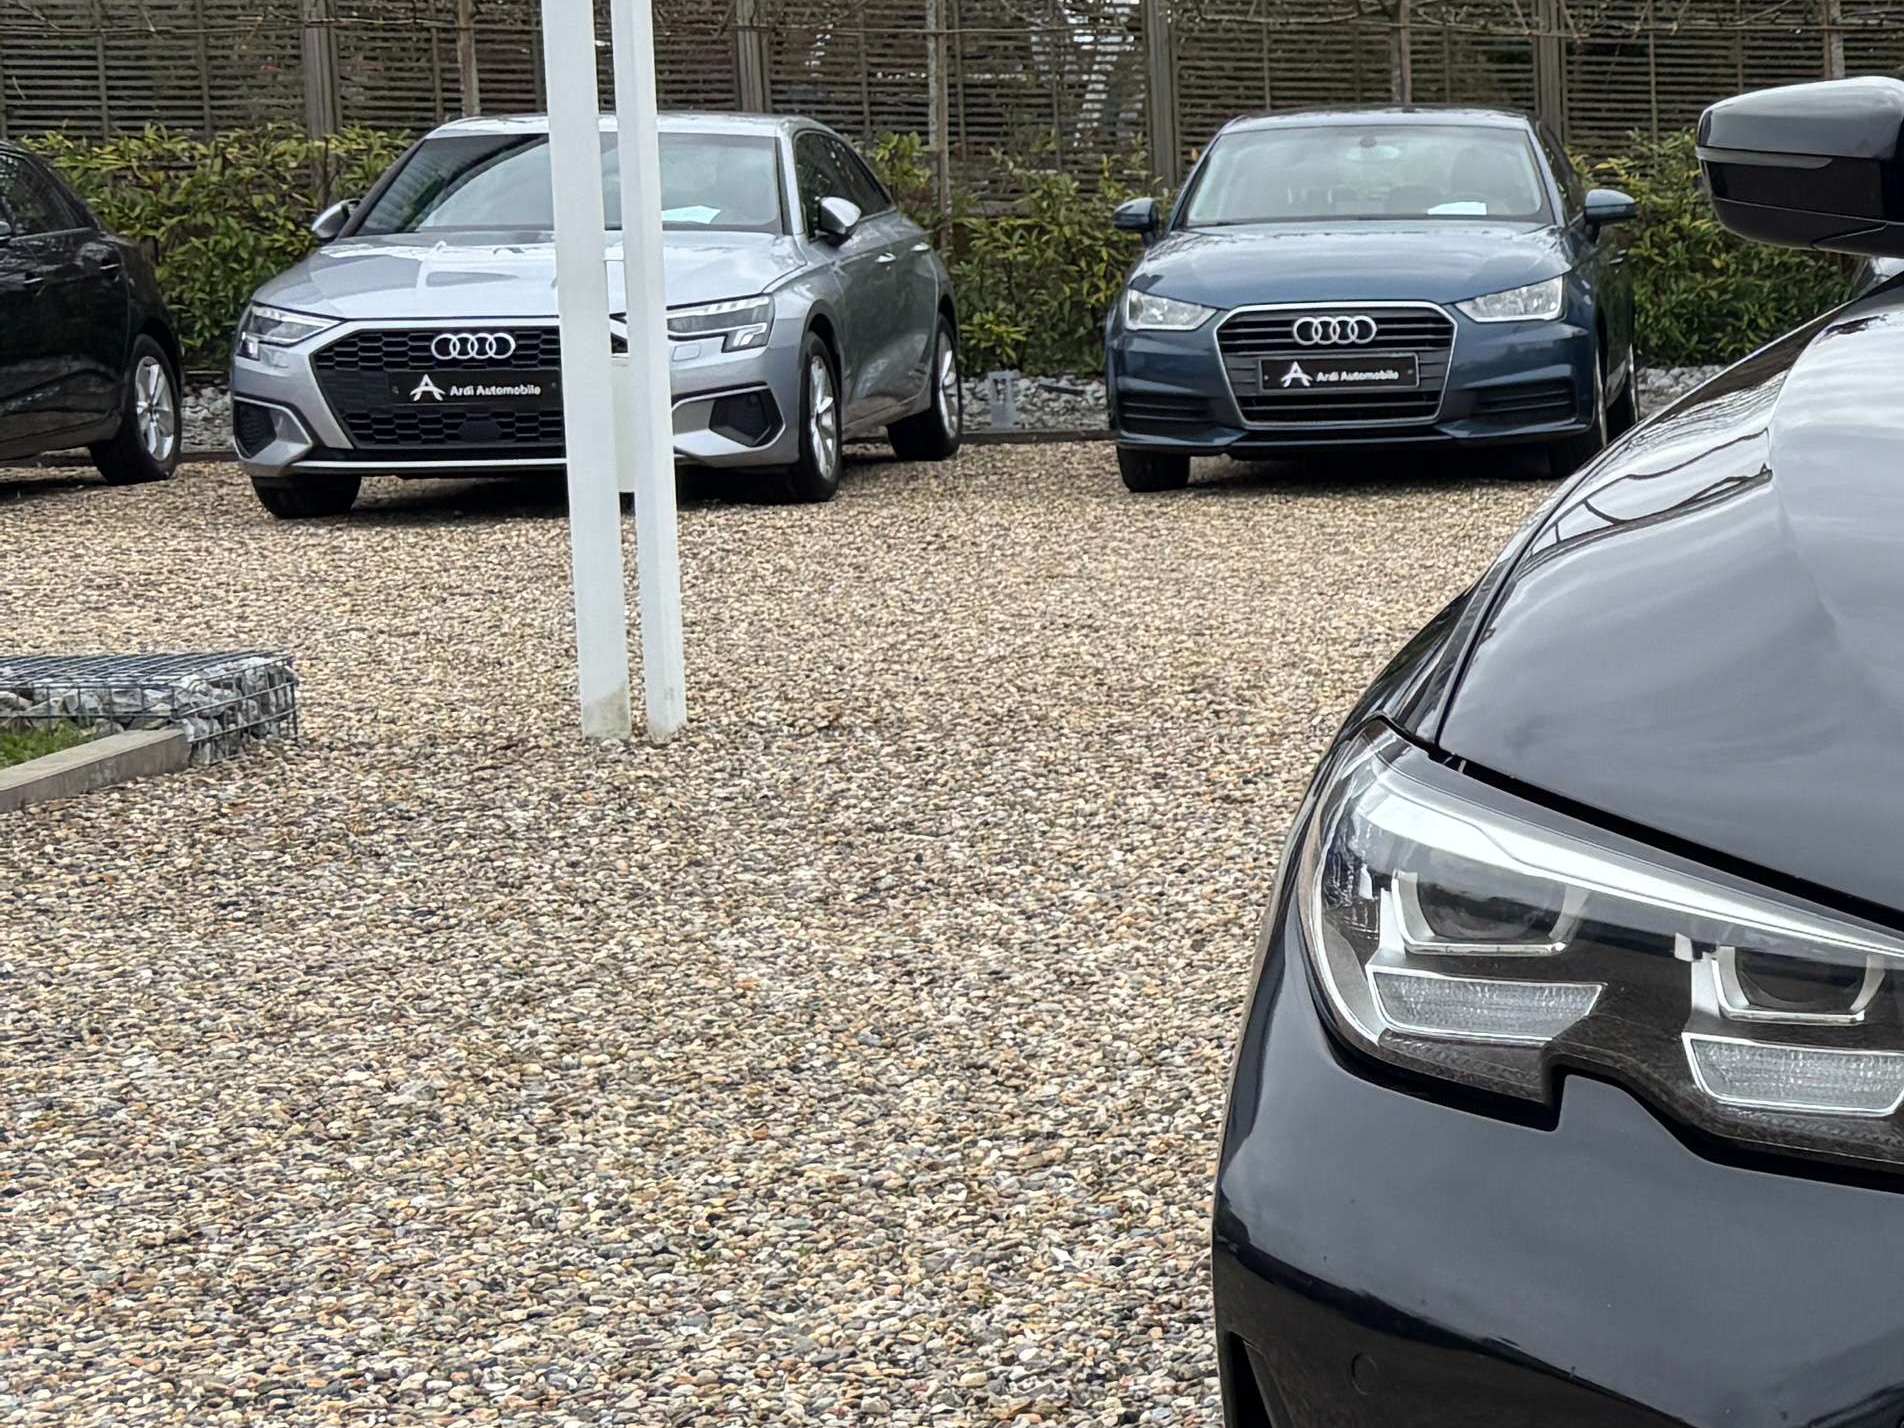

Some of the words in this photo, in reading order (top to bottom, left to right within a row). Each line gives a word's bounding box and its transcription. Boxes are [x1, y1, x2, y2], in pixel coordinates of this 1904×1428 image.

[1315, 371, 1339, 382] Ardi
[1340, 369, 1400, 382] Automobile
[449, 385, 475, 396] Ardi
[476, 384, 542, 396] Automobile
